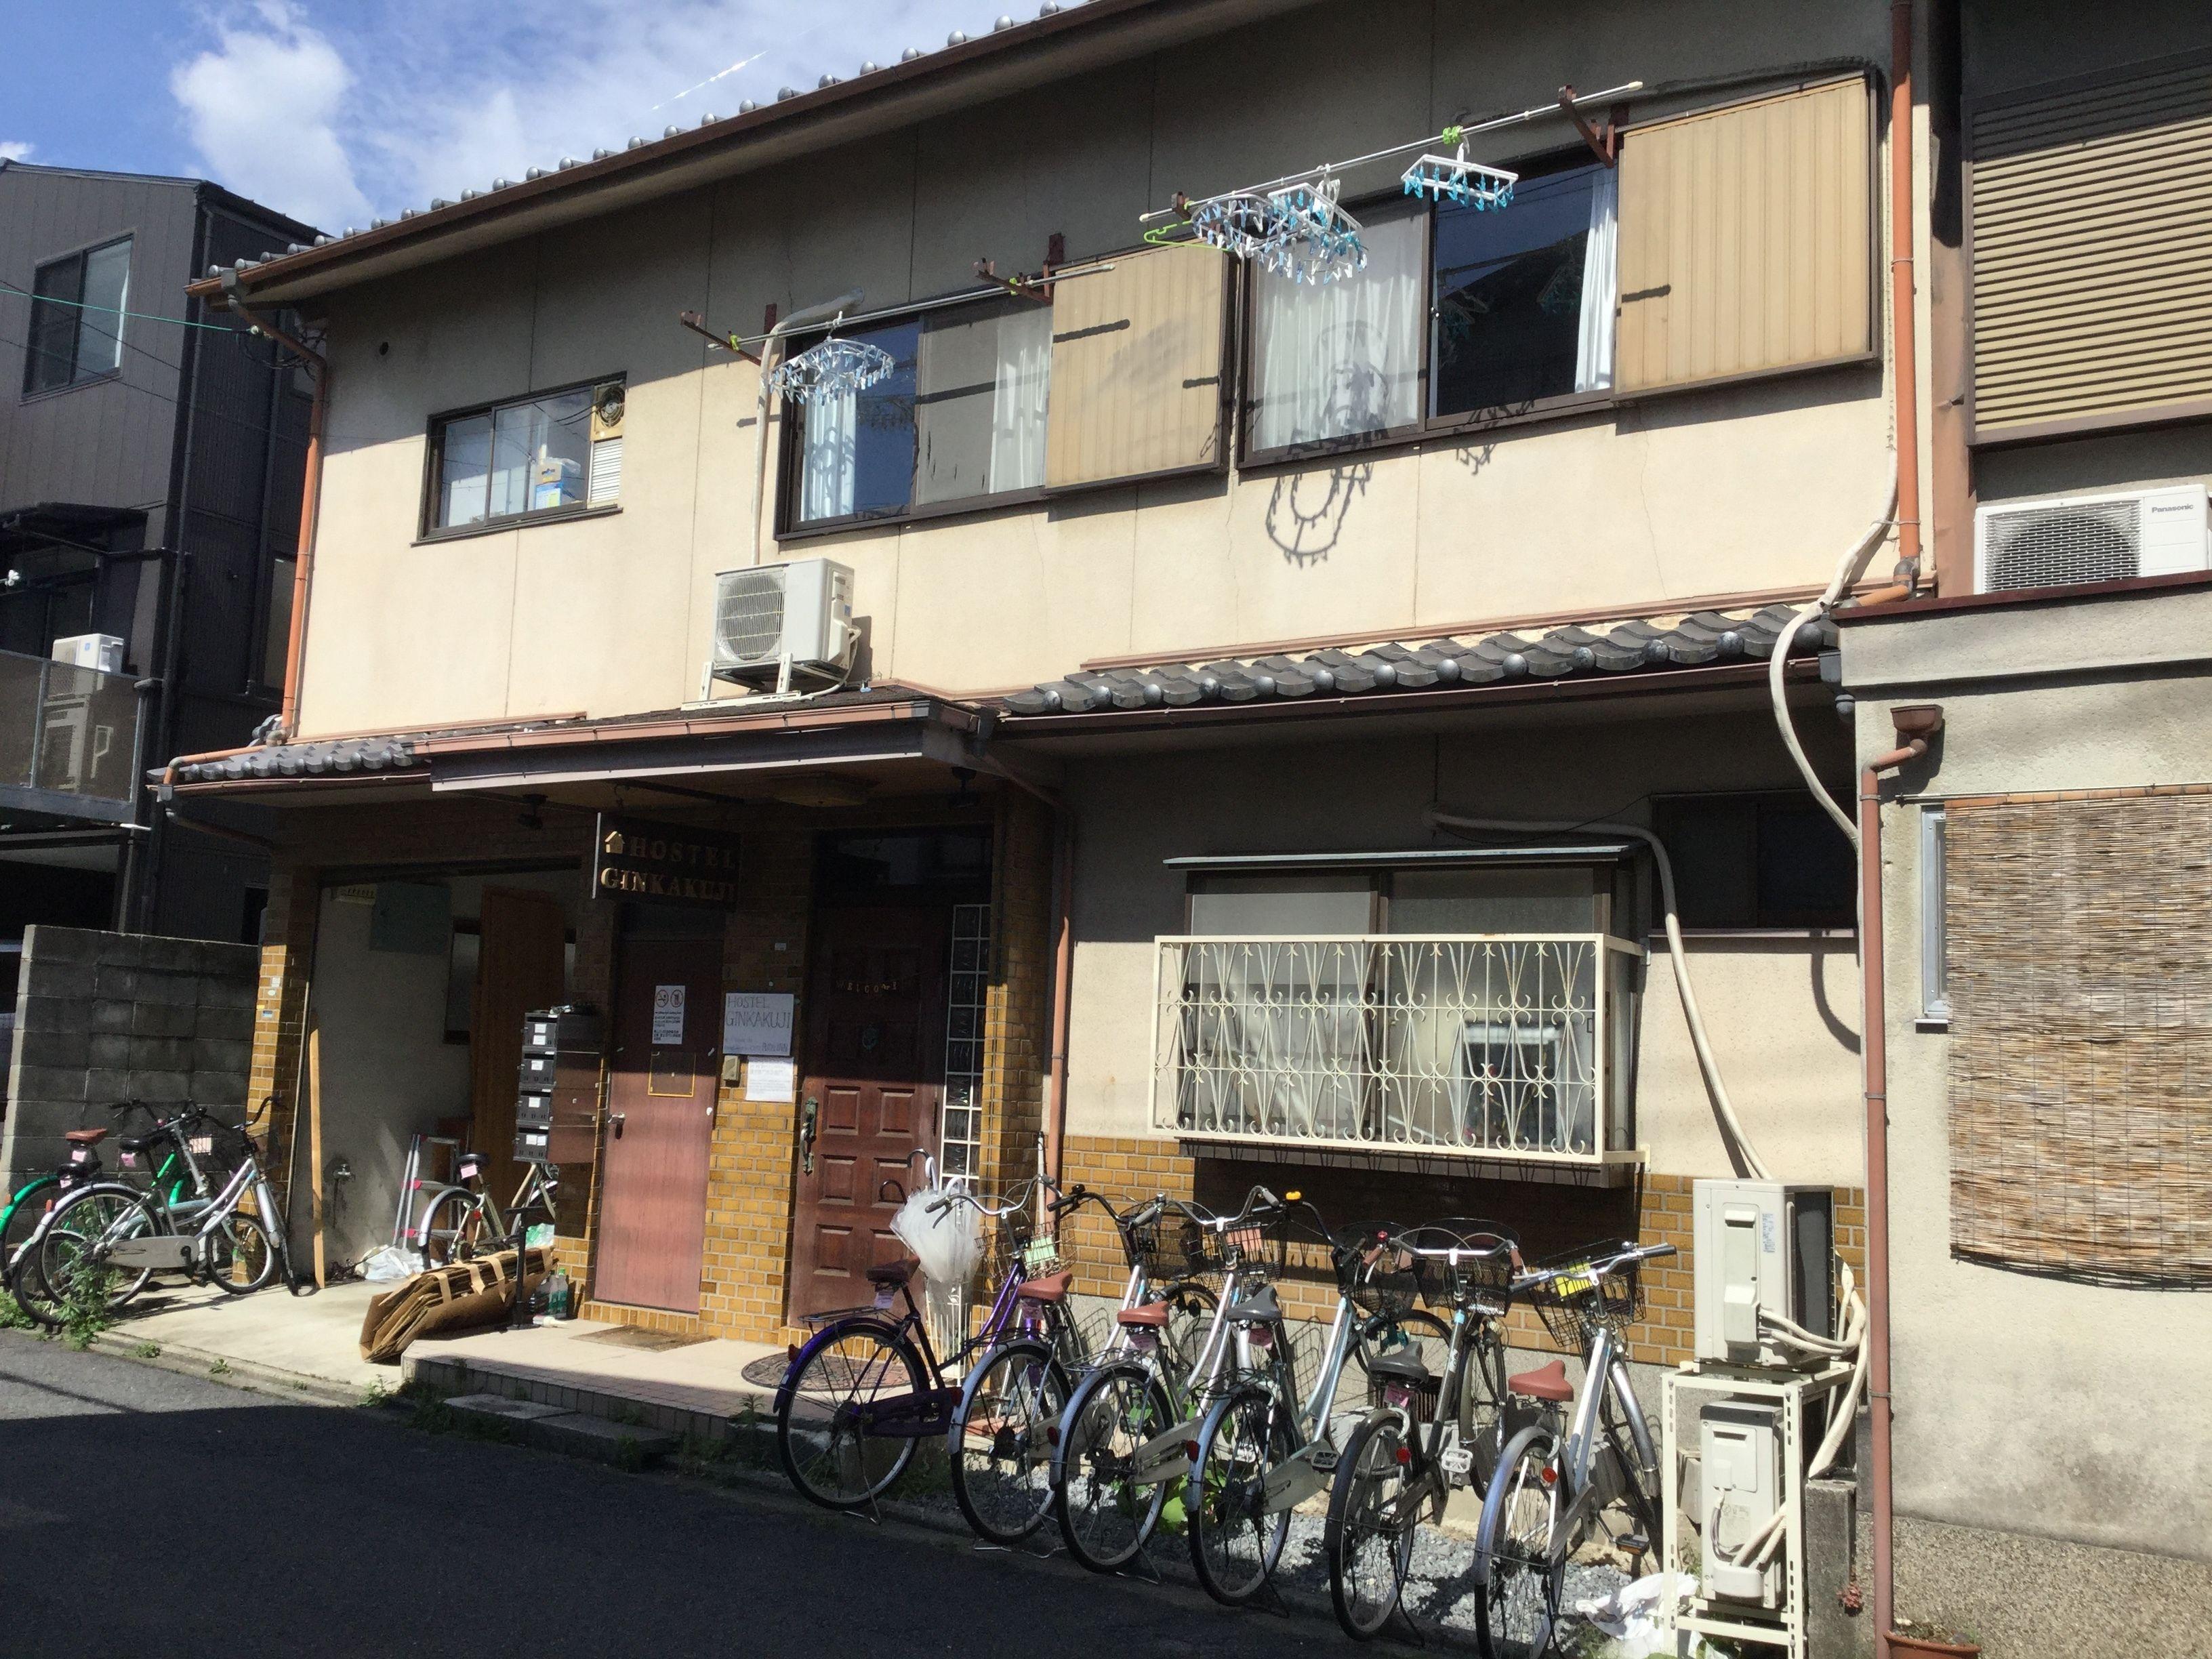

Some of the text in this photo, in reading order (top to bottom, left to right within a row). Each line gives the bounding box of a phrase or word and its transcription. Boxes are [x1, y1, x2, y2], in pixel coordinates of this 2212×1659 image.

[2152, 504, 2194, 513] Panasonic
[629, 836, 737, 869] HOSTEL
[600, 867, 737, 901] GINKAKUJI
[727, 996, 767, 1008] HOSTEL
